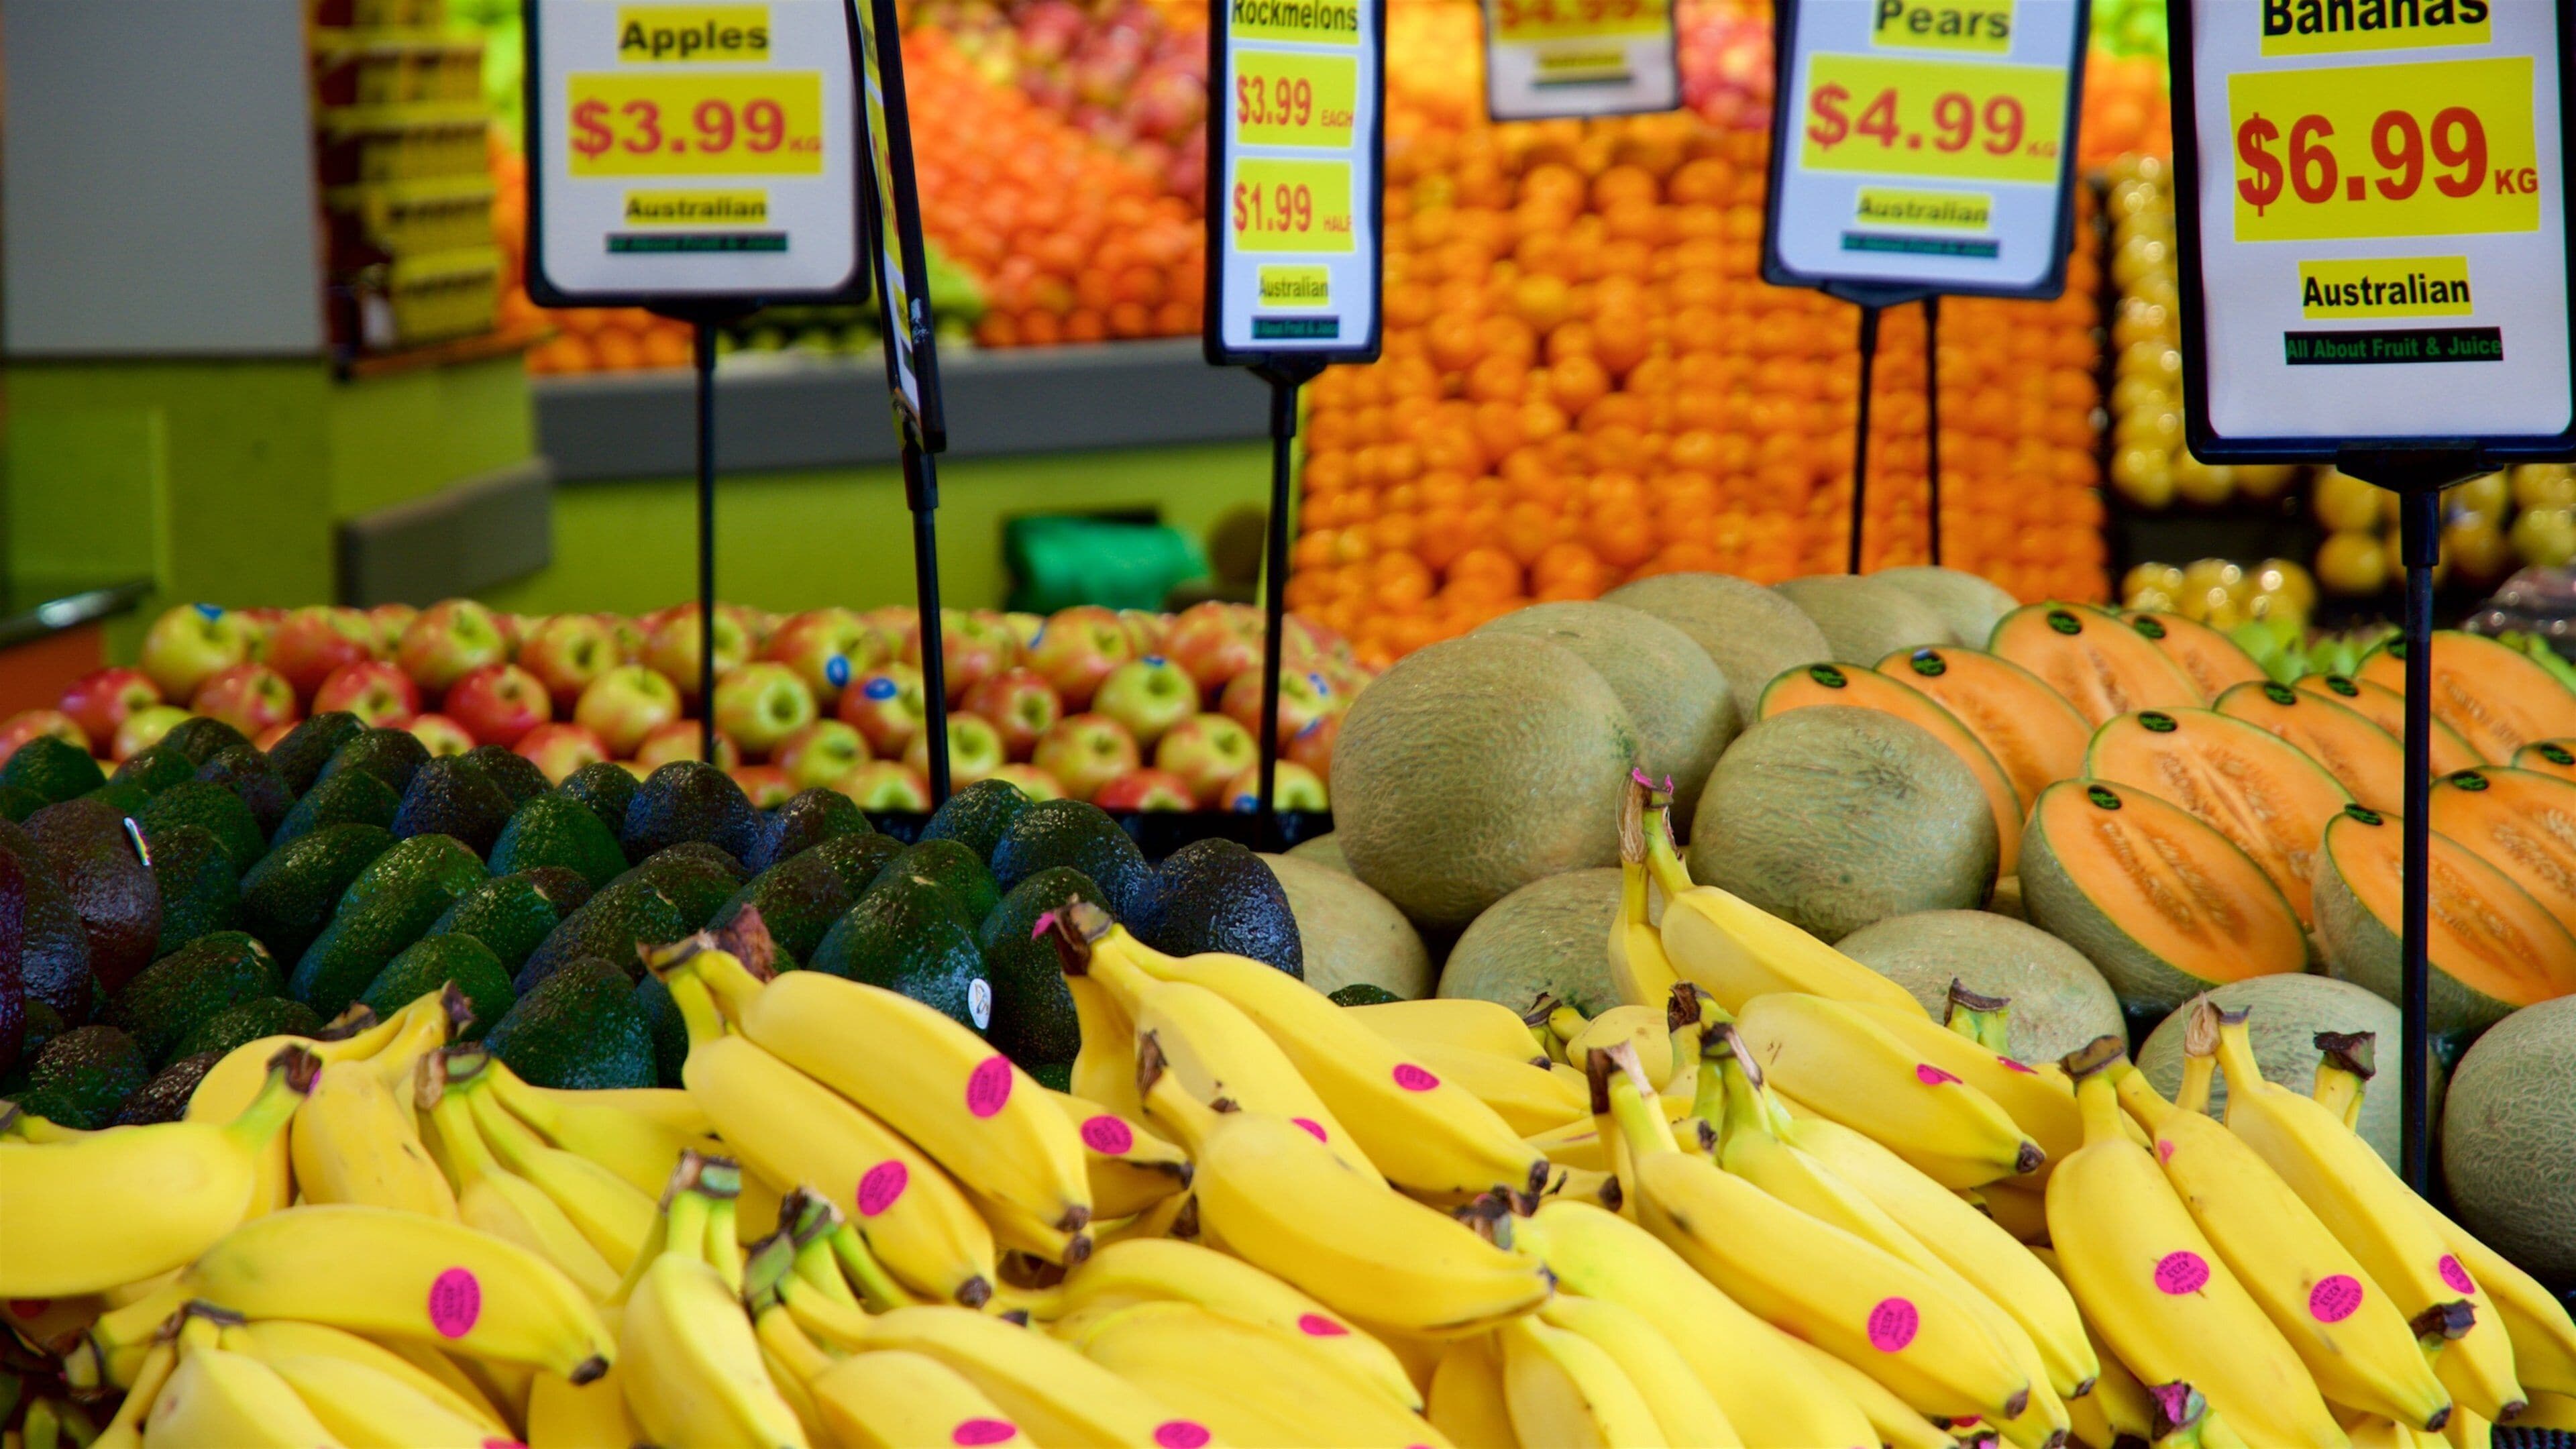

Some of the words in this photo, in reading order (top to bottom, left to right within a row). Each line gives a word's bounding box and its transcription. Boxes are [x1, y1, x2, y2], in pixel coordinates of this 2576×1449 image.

[1232, 0, 1358, 31] Rockmelons
[1876, 0, 2010, 38] Pears
[2263, 0, 2489, 36] Bananas
[620, 19, 769, 58] Apples
[1236, 74, 1313, 129] $3.99
[1321, 109, 1354, 128] EACH
[1806, 80, 2025, 156] $4.99
[570, 96, 786, 160] $3.99
[2237, 106, 2487, 217] $6.99
[2495, 167, 2538, 195] KG
[625, 197, 767, 220] Australian
[1233, 181, 1313, 235] $1.99
[1323, 215, 1352, 233] HALF
[1857, 195, 1988, 224] Australian
[1258, 276, 1328, 298] Australian
[2303, 274, 2470, 307] Australian
[2286, 339, 2309, 358] All
[2314, 338, 2367, 358] About
[2372, 337, 2419, 357] Fruit
[2425, 335, 2440, 356] &
[2447, 335, 2502, 356] Juice
